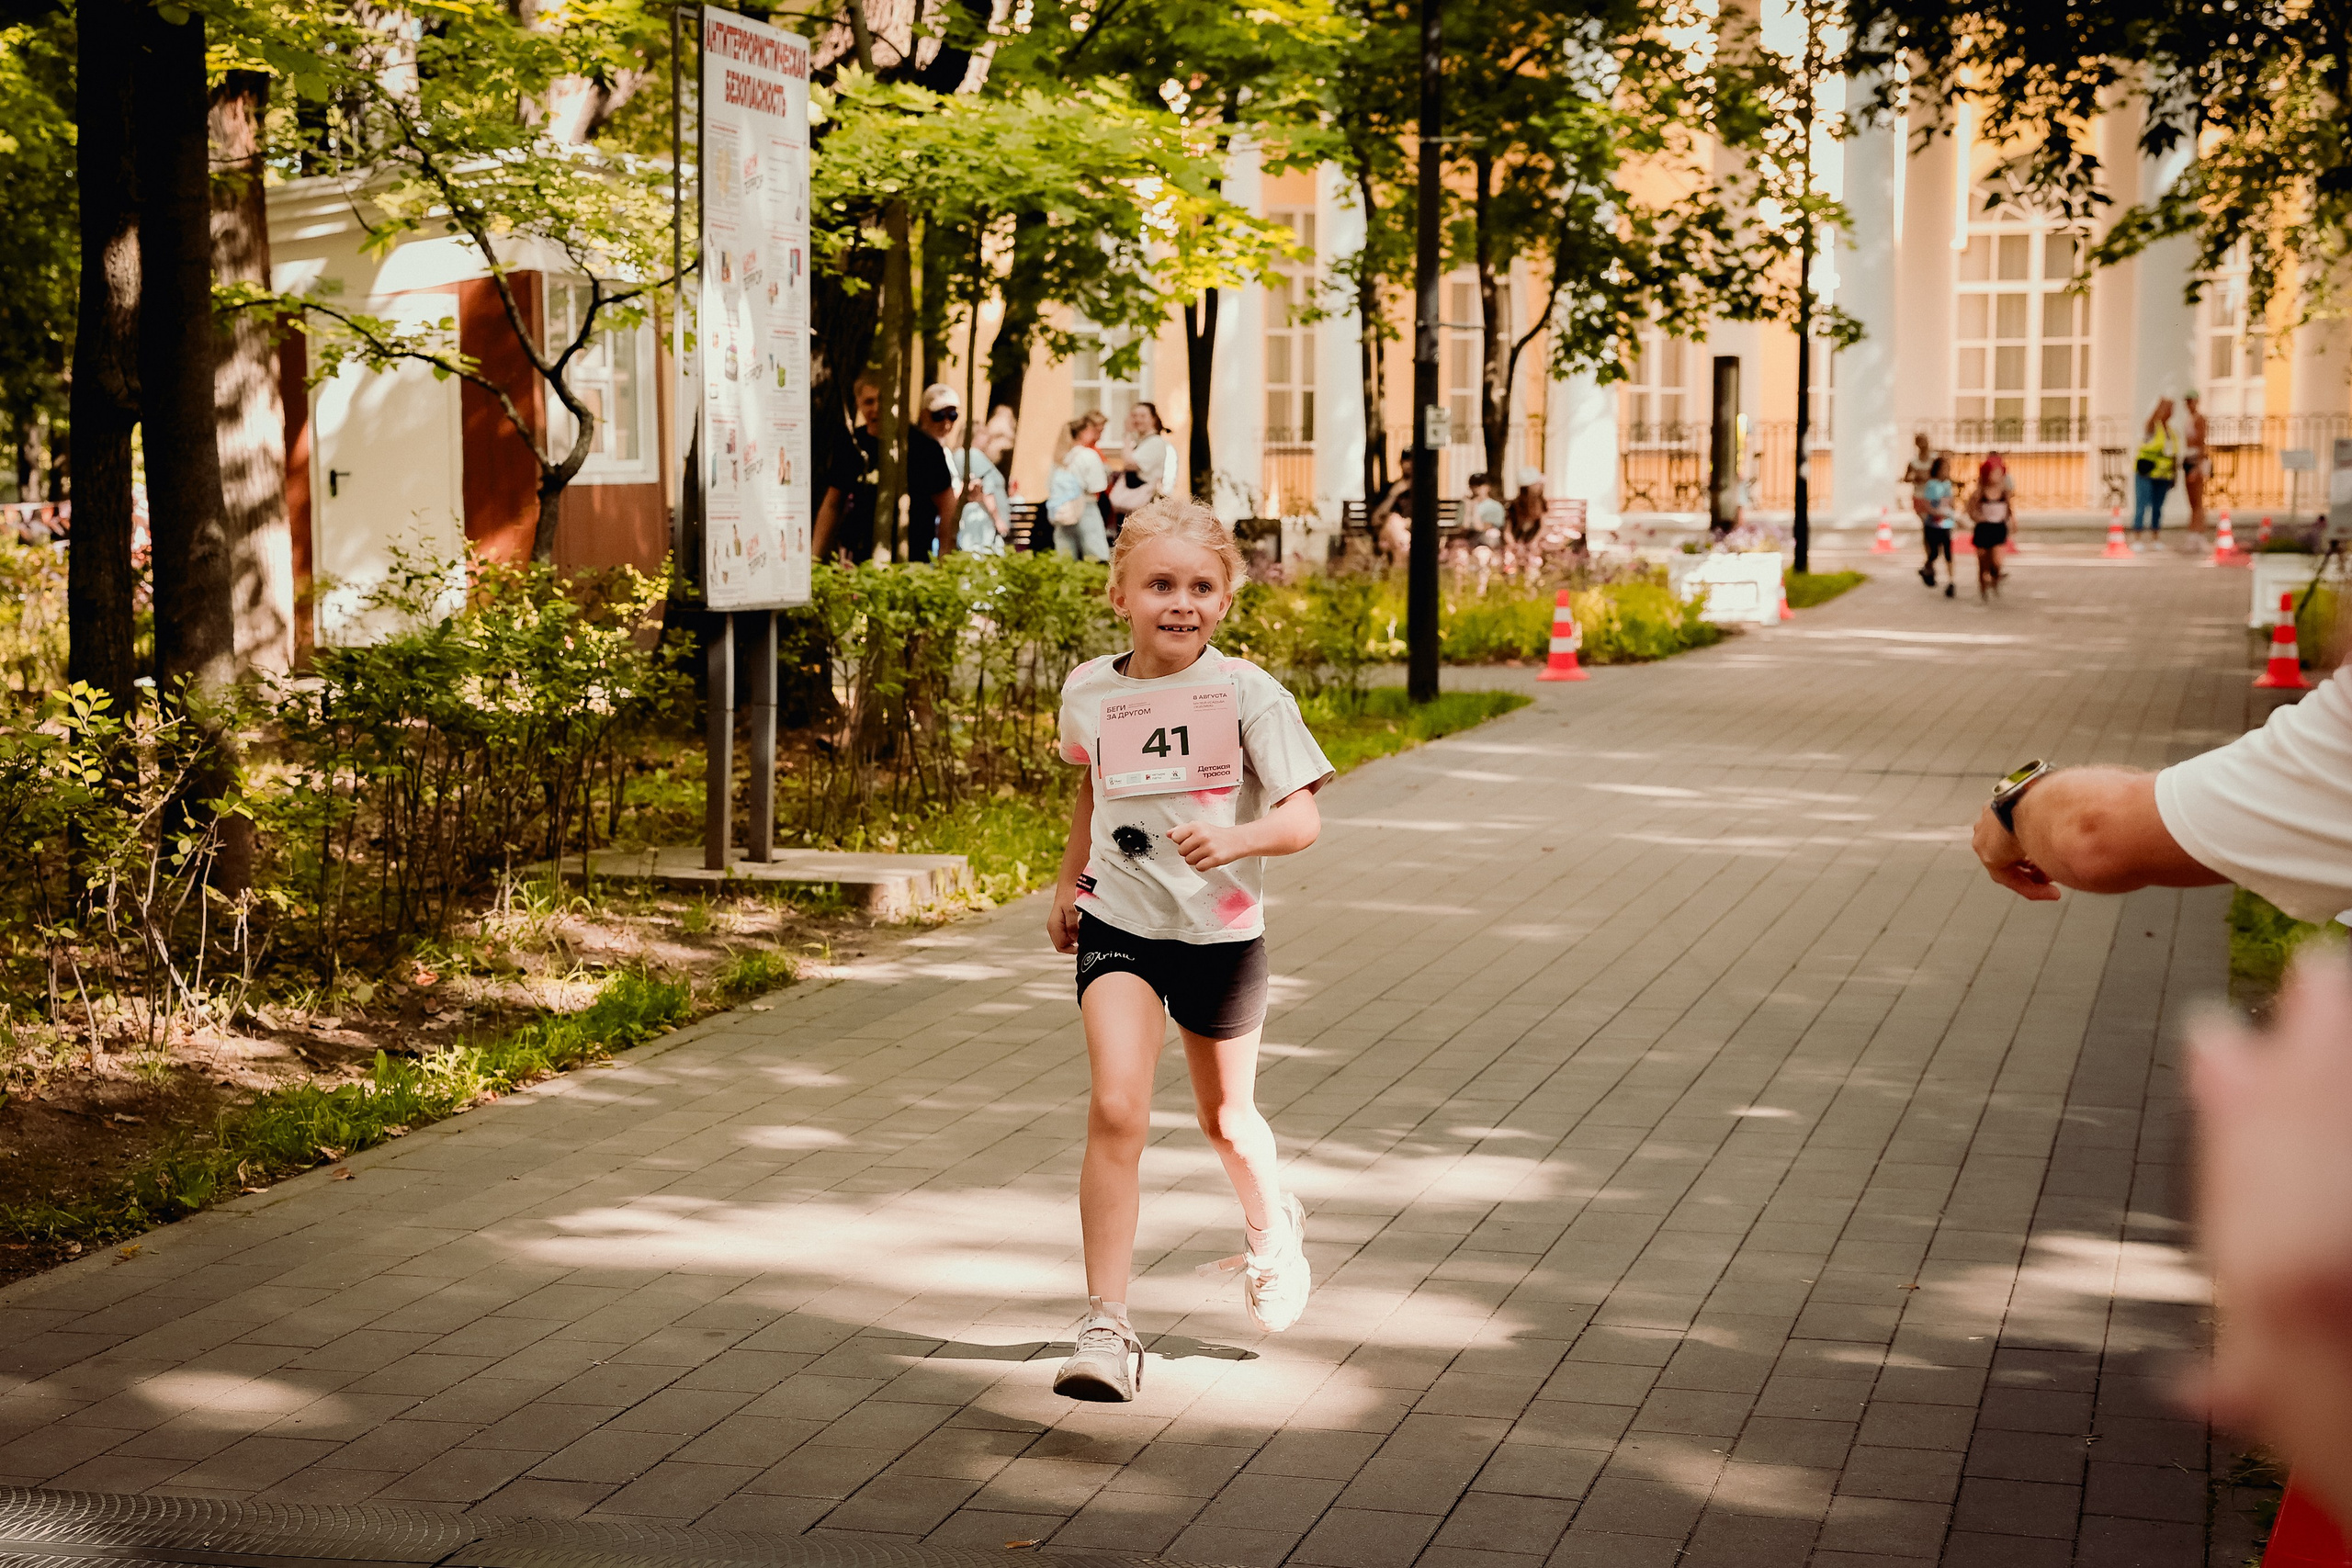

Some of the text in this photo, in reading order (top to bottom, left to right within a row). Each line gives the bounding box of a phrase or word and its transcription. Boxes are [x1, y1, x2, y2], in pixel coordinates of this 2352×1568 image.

[1106, 705, 1126, 714] БЕГИ
[1106, 707, 1151, 721] ЗА ДРУГОМ
[1142, 725, 1190, 758] 41
[1197, 764, 1231, 773] Детская
[1203, 770, 1231, 779] трасса
